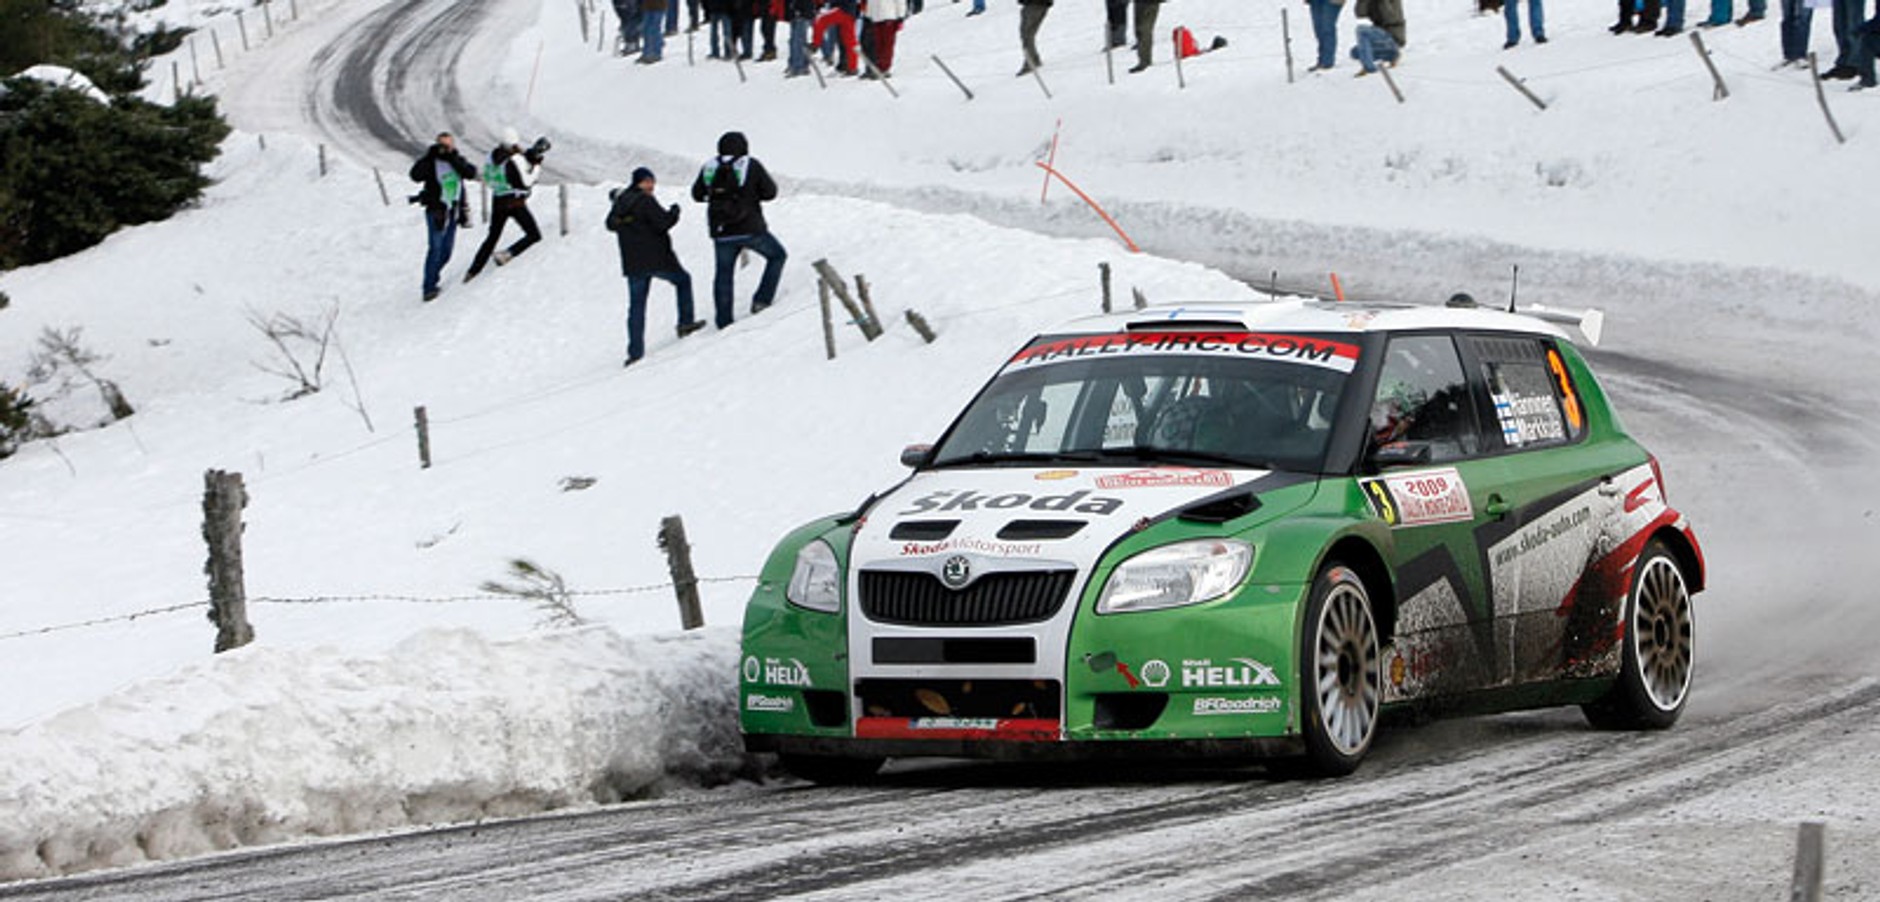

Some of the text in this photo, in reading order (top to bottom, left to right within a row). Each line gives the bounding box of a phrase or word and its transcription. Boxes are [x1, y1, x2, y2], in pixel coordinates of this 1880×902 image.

[1025, 335, 1337, 364] RALLY-IRC.COM
[1547, 349, 1580, 428] 3
[1405, 477, 1448, 496] 2009
[1370, 481, 1394, 525] 3
[766, 658, 813, 687] HELIX
[1182, 657, 1281, 687] HELIX
[1193, 696, 1282, 714] BFGoodrich
